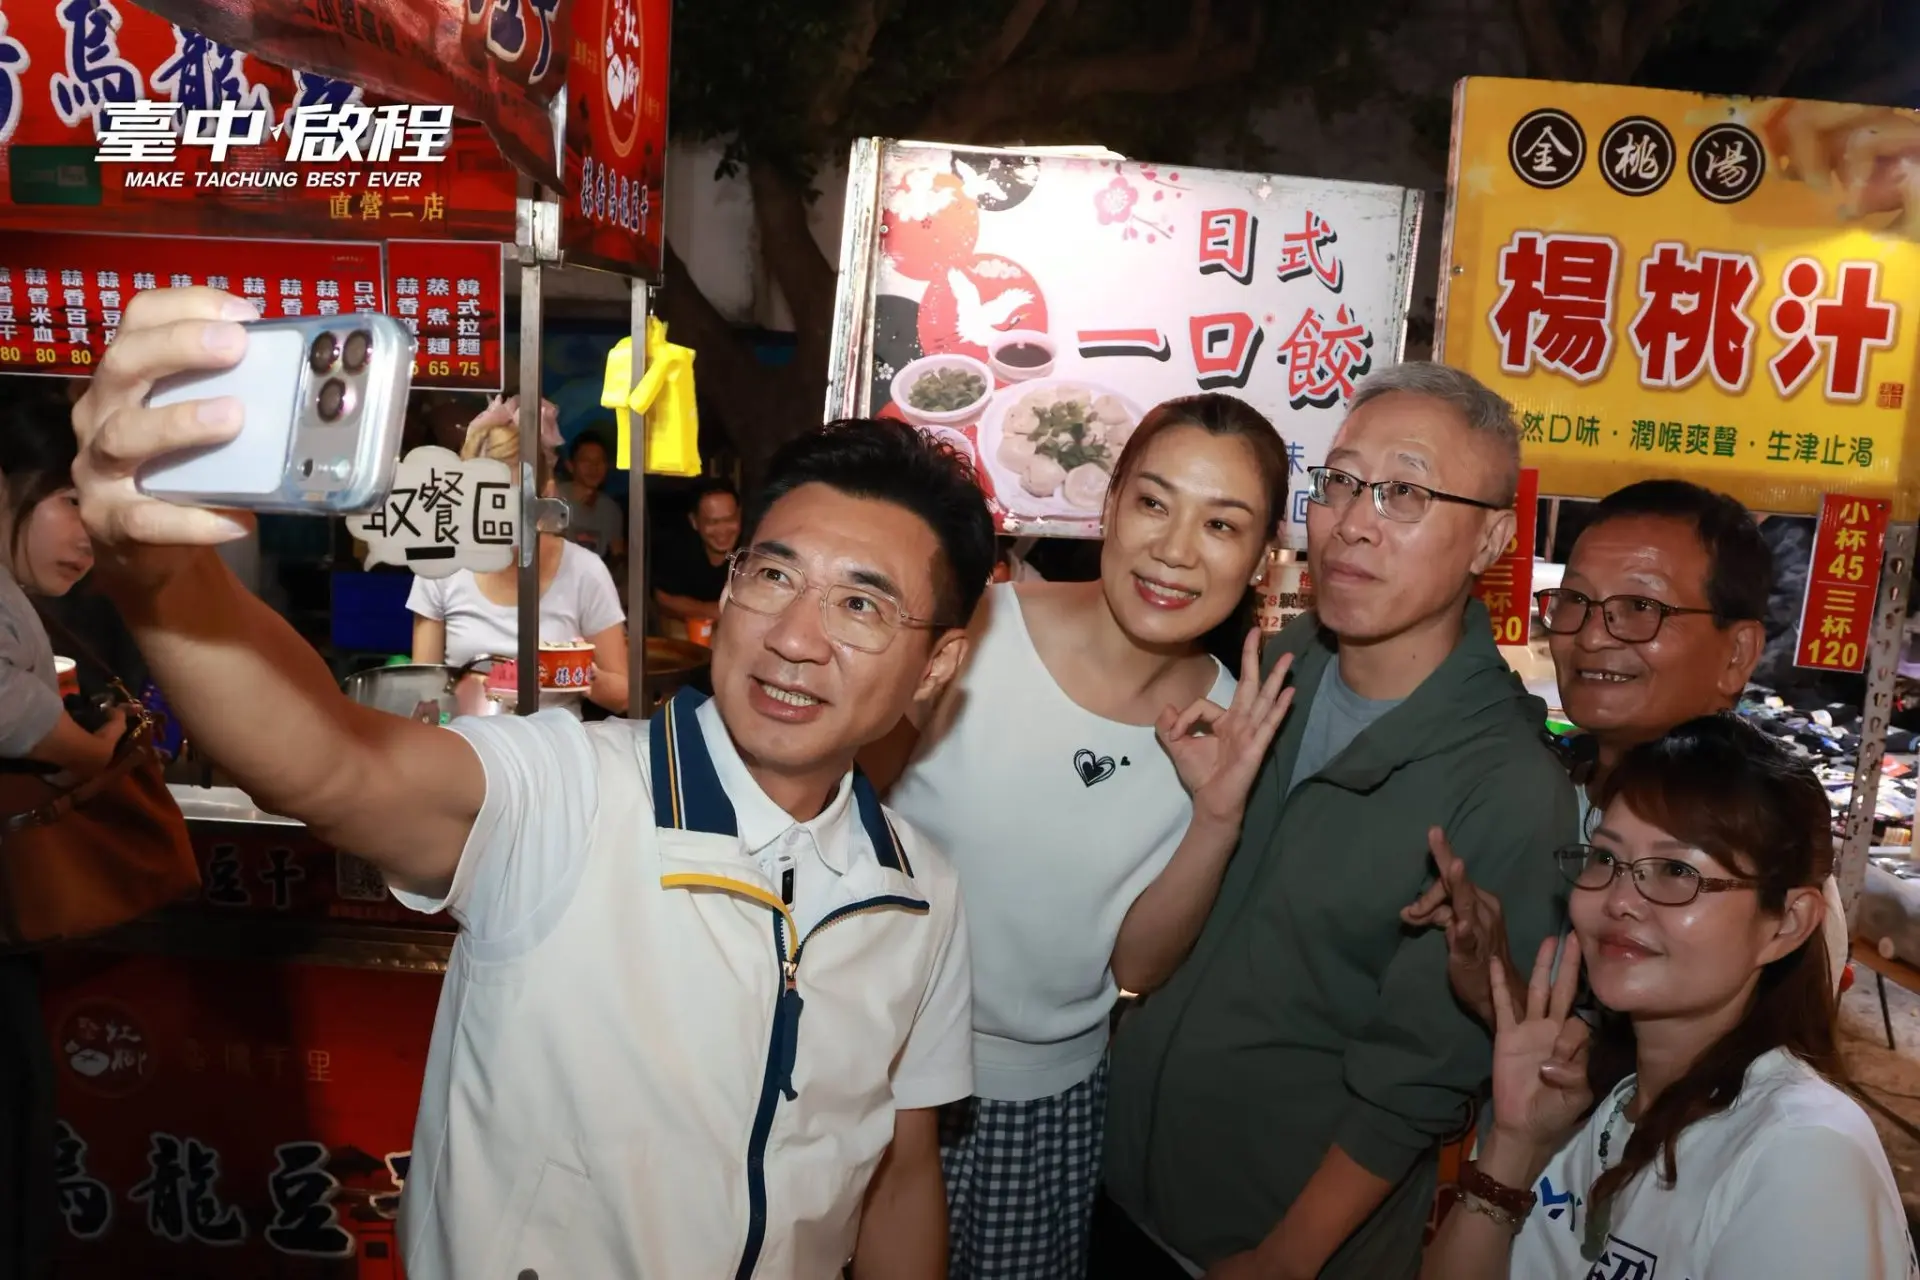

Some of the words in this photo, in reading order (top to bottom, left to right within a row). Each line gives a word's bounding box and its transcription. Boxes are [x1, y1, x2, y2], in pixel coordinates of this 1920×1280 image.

[329, 191, 445, 222] 直營二店
[1196, 208, 1345, 294] 日式
[25, 267, 55, 343] 蒜香米血
[456, 278, 481, 356] 韓式拉麵
[1488, 230, 1897, 405] 楊桃汁
[0, 346, 20, 362] 80
[36, 347, 56, 363] 80
[71, 349, 91, 365] 80
[428, 360, 450, 376] 65
[458, 361, 481, 377] 75
[1076, 303, 1374, 412] 一口餃
[1834, 500, 1871, 552] 小杯
[1828, 553, 1865, 581] 45
[1820, 588, 1858, 639] 三杯
[1808, 638, 1859, 667] 120
[206, 843, 306, 911] 豆干
